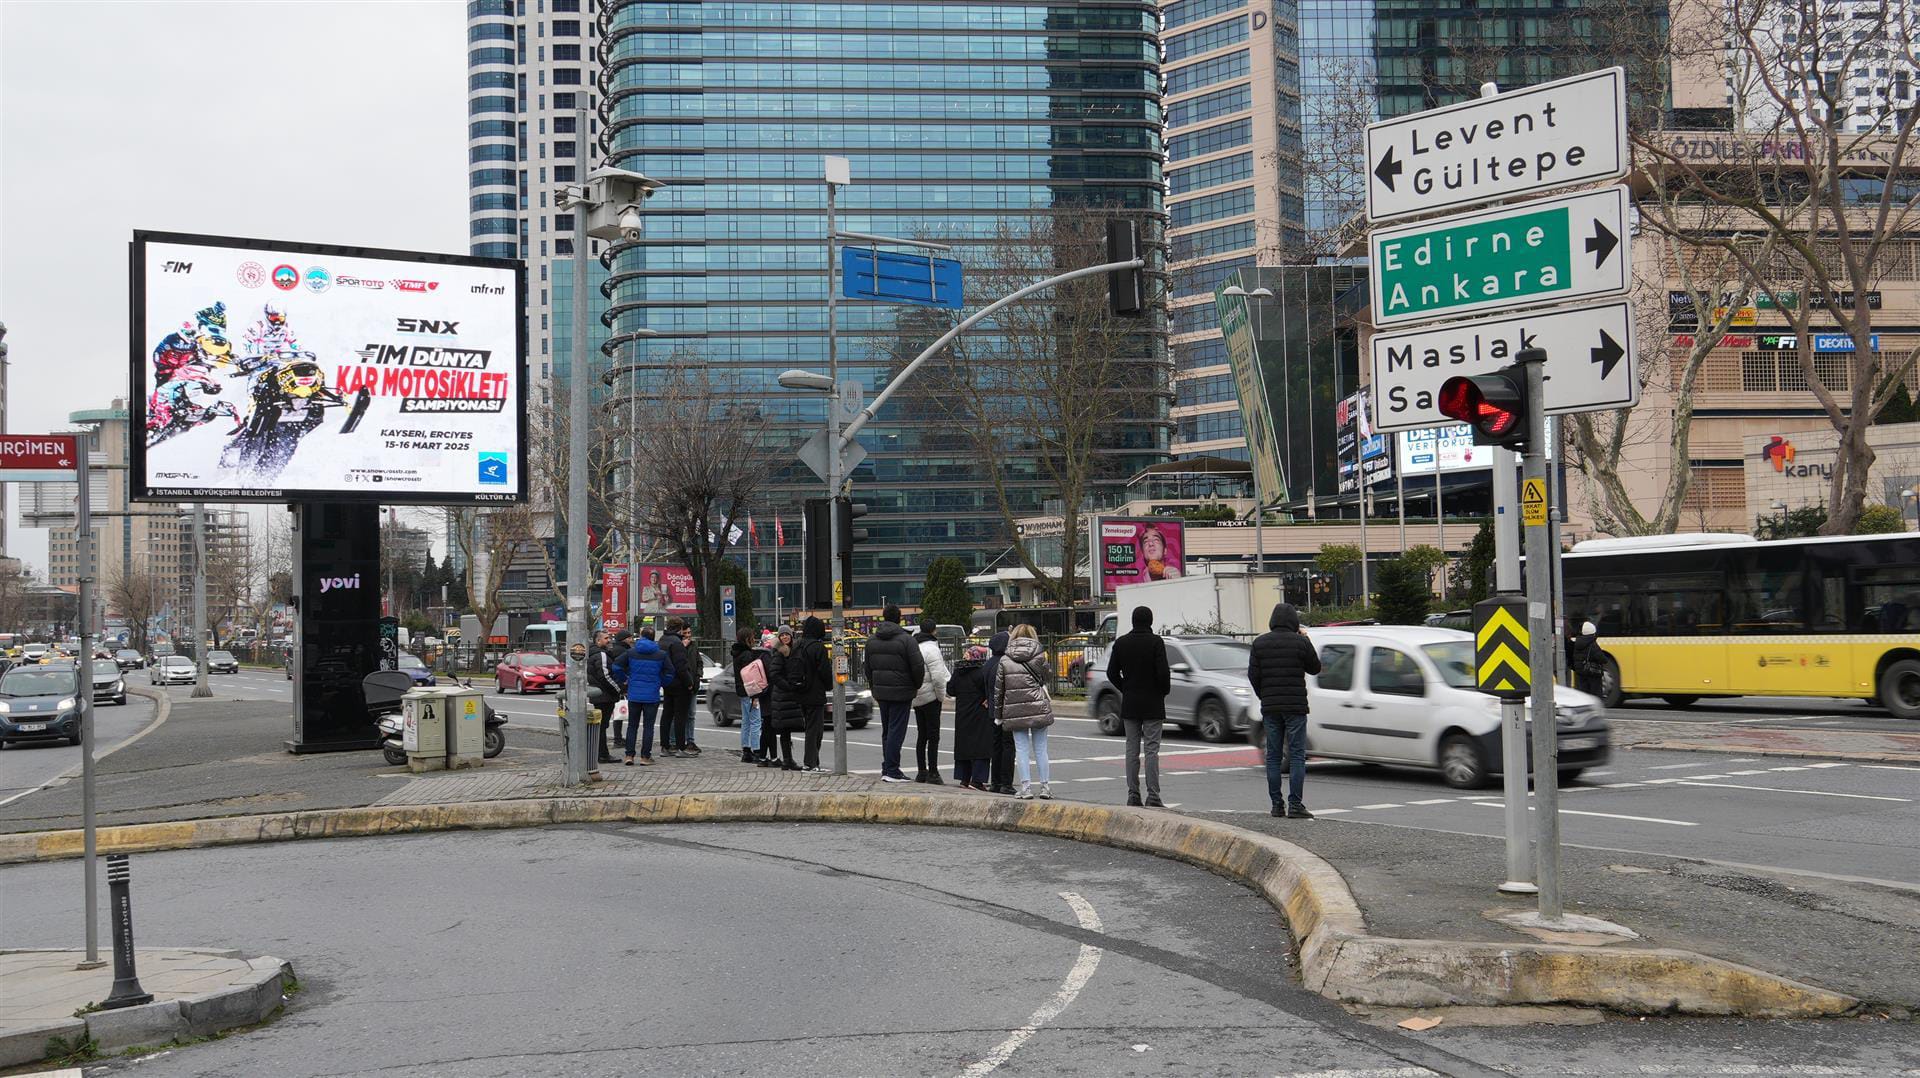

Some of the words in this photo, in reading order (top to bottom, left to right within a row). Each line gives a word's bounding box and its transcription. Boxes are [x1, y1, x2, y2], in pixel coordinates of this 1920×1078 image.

[1252, 10, 1267, 30] D
[1412, 102, 1557, 155] Levent
[1413, 145, 1586, 195] Gültepe
[1385, 225, 1546, 271] Edirne
[160, 261, 193, 274] FIM
[403, 281, 425, 290] TMF
[1388, 265, 1558, 310] Ankara
[397, 317, 460, 336] SNX
[355, 343, 409, 366] FIM
[412, 349, 485, 369] DÜNYA
[1387, 328, 1539, 373] Maslak
[336, 365, 378, 398] KAR
[382, 367, 509, 401] MOTOSİKLETİ
[405, 398, 501, 413] ŞAMPİYONASI
[380, 428, 428, 439] KAYSERİ,
[429, 430, 474, 440] ERCİYES
[0, 440, 65, 457] RÇİMEN
[385, 440, 410, 450] 15-16
[411, 441, 443, 450] MART
[444, 442, 471, 451] 2025
[1785, 463, 1848, 481] kany
[193, 489, 240, 498] BÜYÜKŞEHİR
[475, 493, 503, 501] KÜLTÜR
[1025, 521, 1062, 530] WYNDHAM
[320, 573, 360, 593] yovi
[724, 603, 733, 614] P
[603, 620, 619, 628] 49
